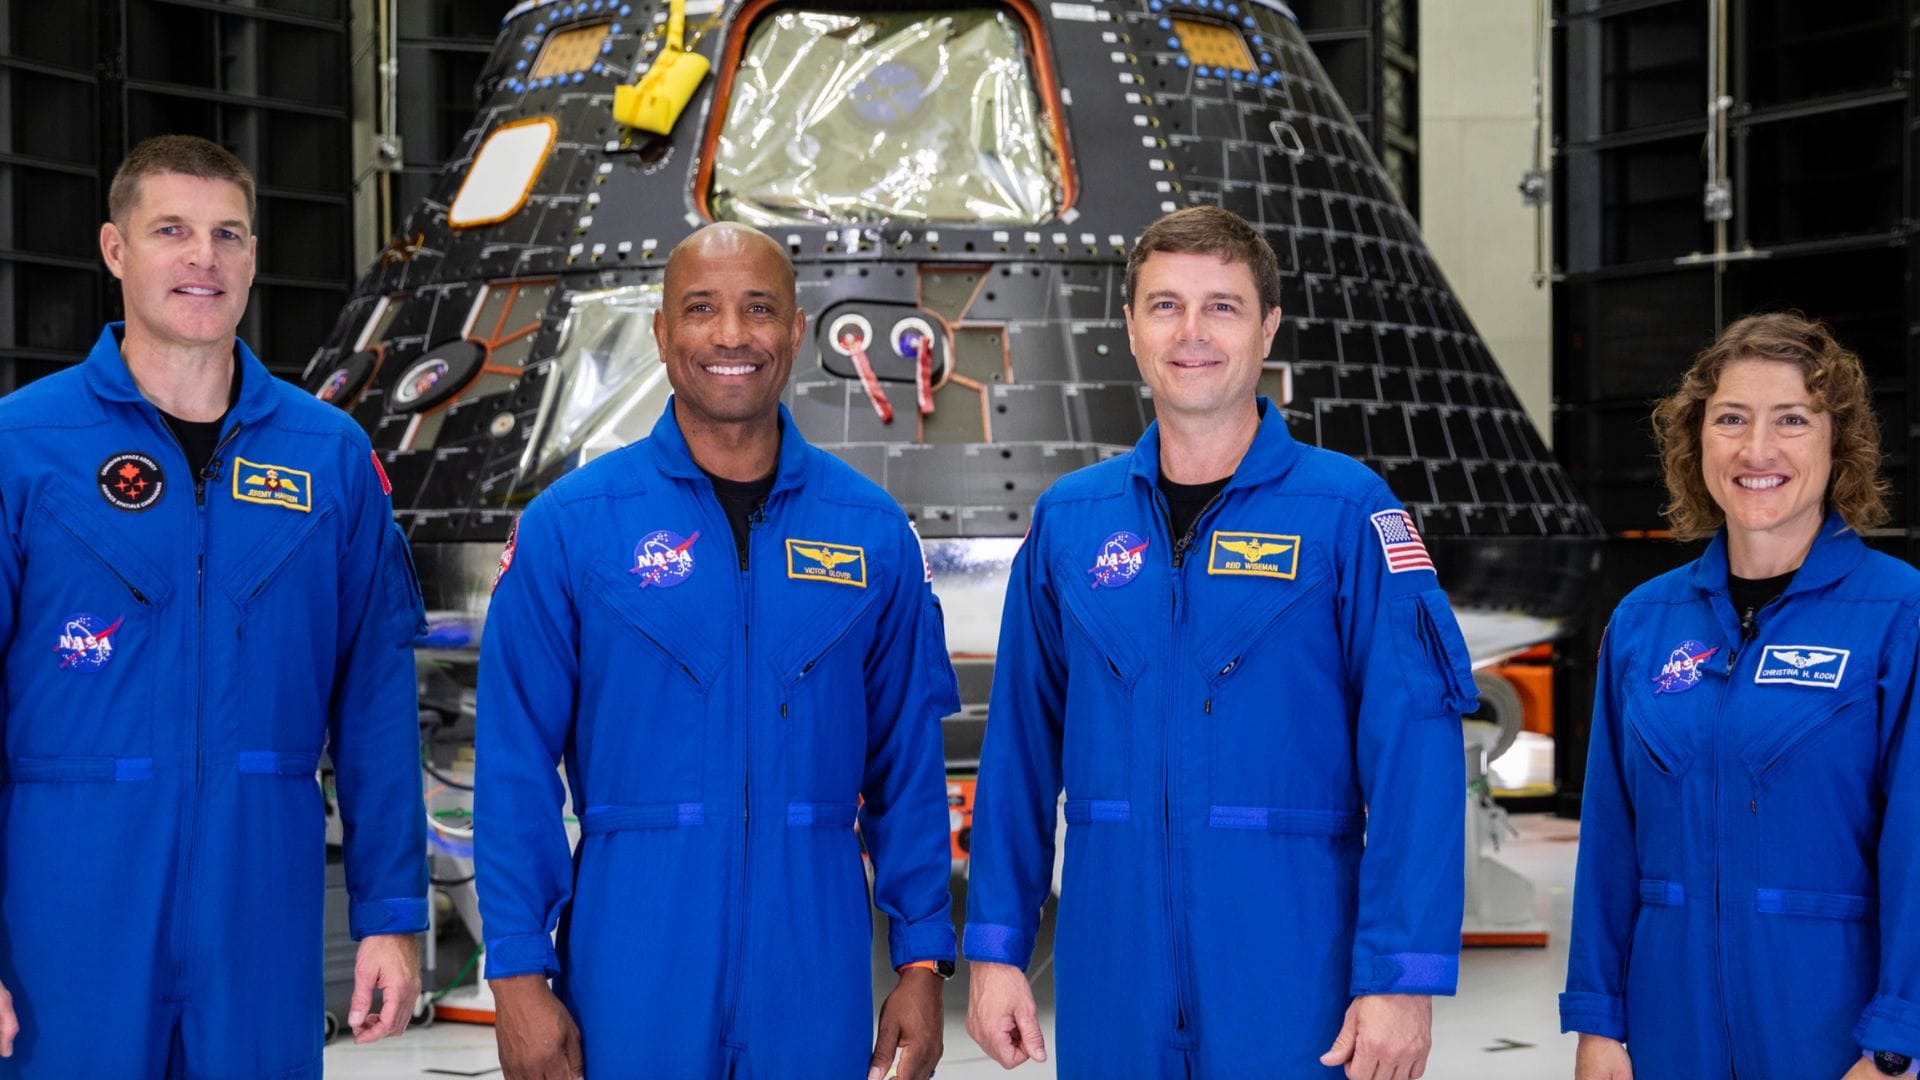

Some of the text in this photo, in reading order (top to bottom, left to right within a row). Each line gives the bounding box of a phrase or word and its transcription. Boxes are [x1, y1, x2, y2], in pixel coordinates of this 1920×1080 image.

[139, 456, 158, 471] AGENCY
[248, 489, 272, 498] JEREMY
[637, 550, 693, 571] NASA
[1096, 551, 1142, 571] NASA
[1225, 561, 1279, 572] REID WISEMAN
[804, 567, 851, 579] VICTOR GLOVER
[60, 635, 113, 657] NASA
[1762, 668, 1836, 680] CHRISTINA H. KOCH
